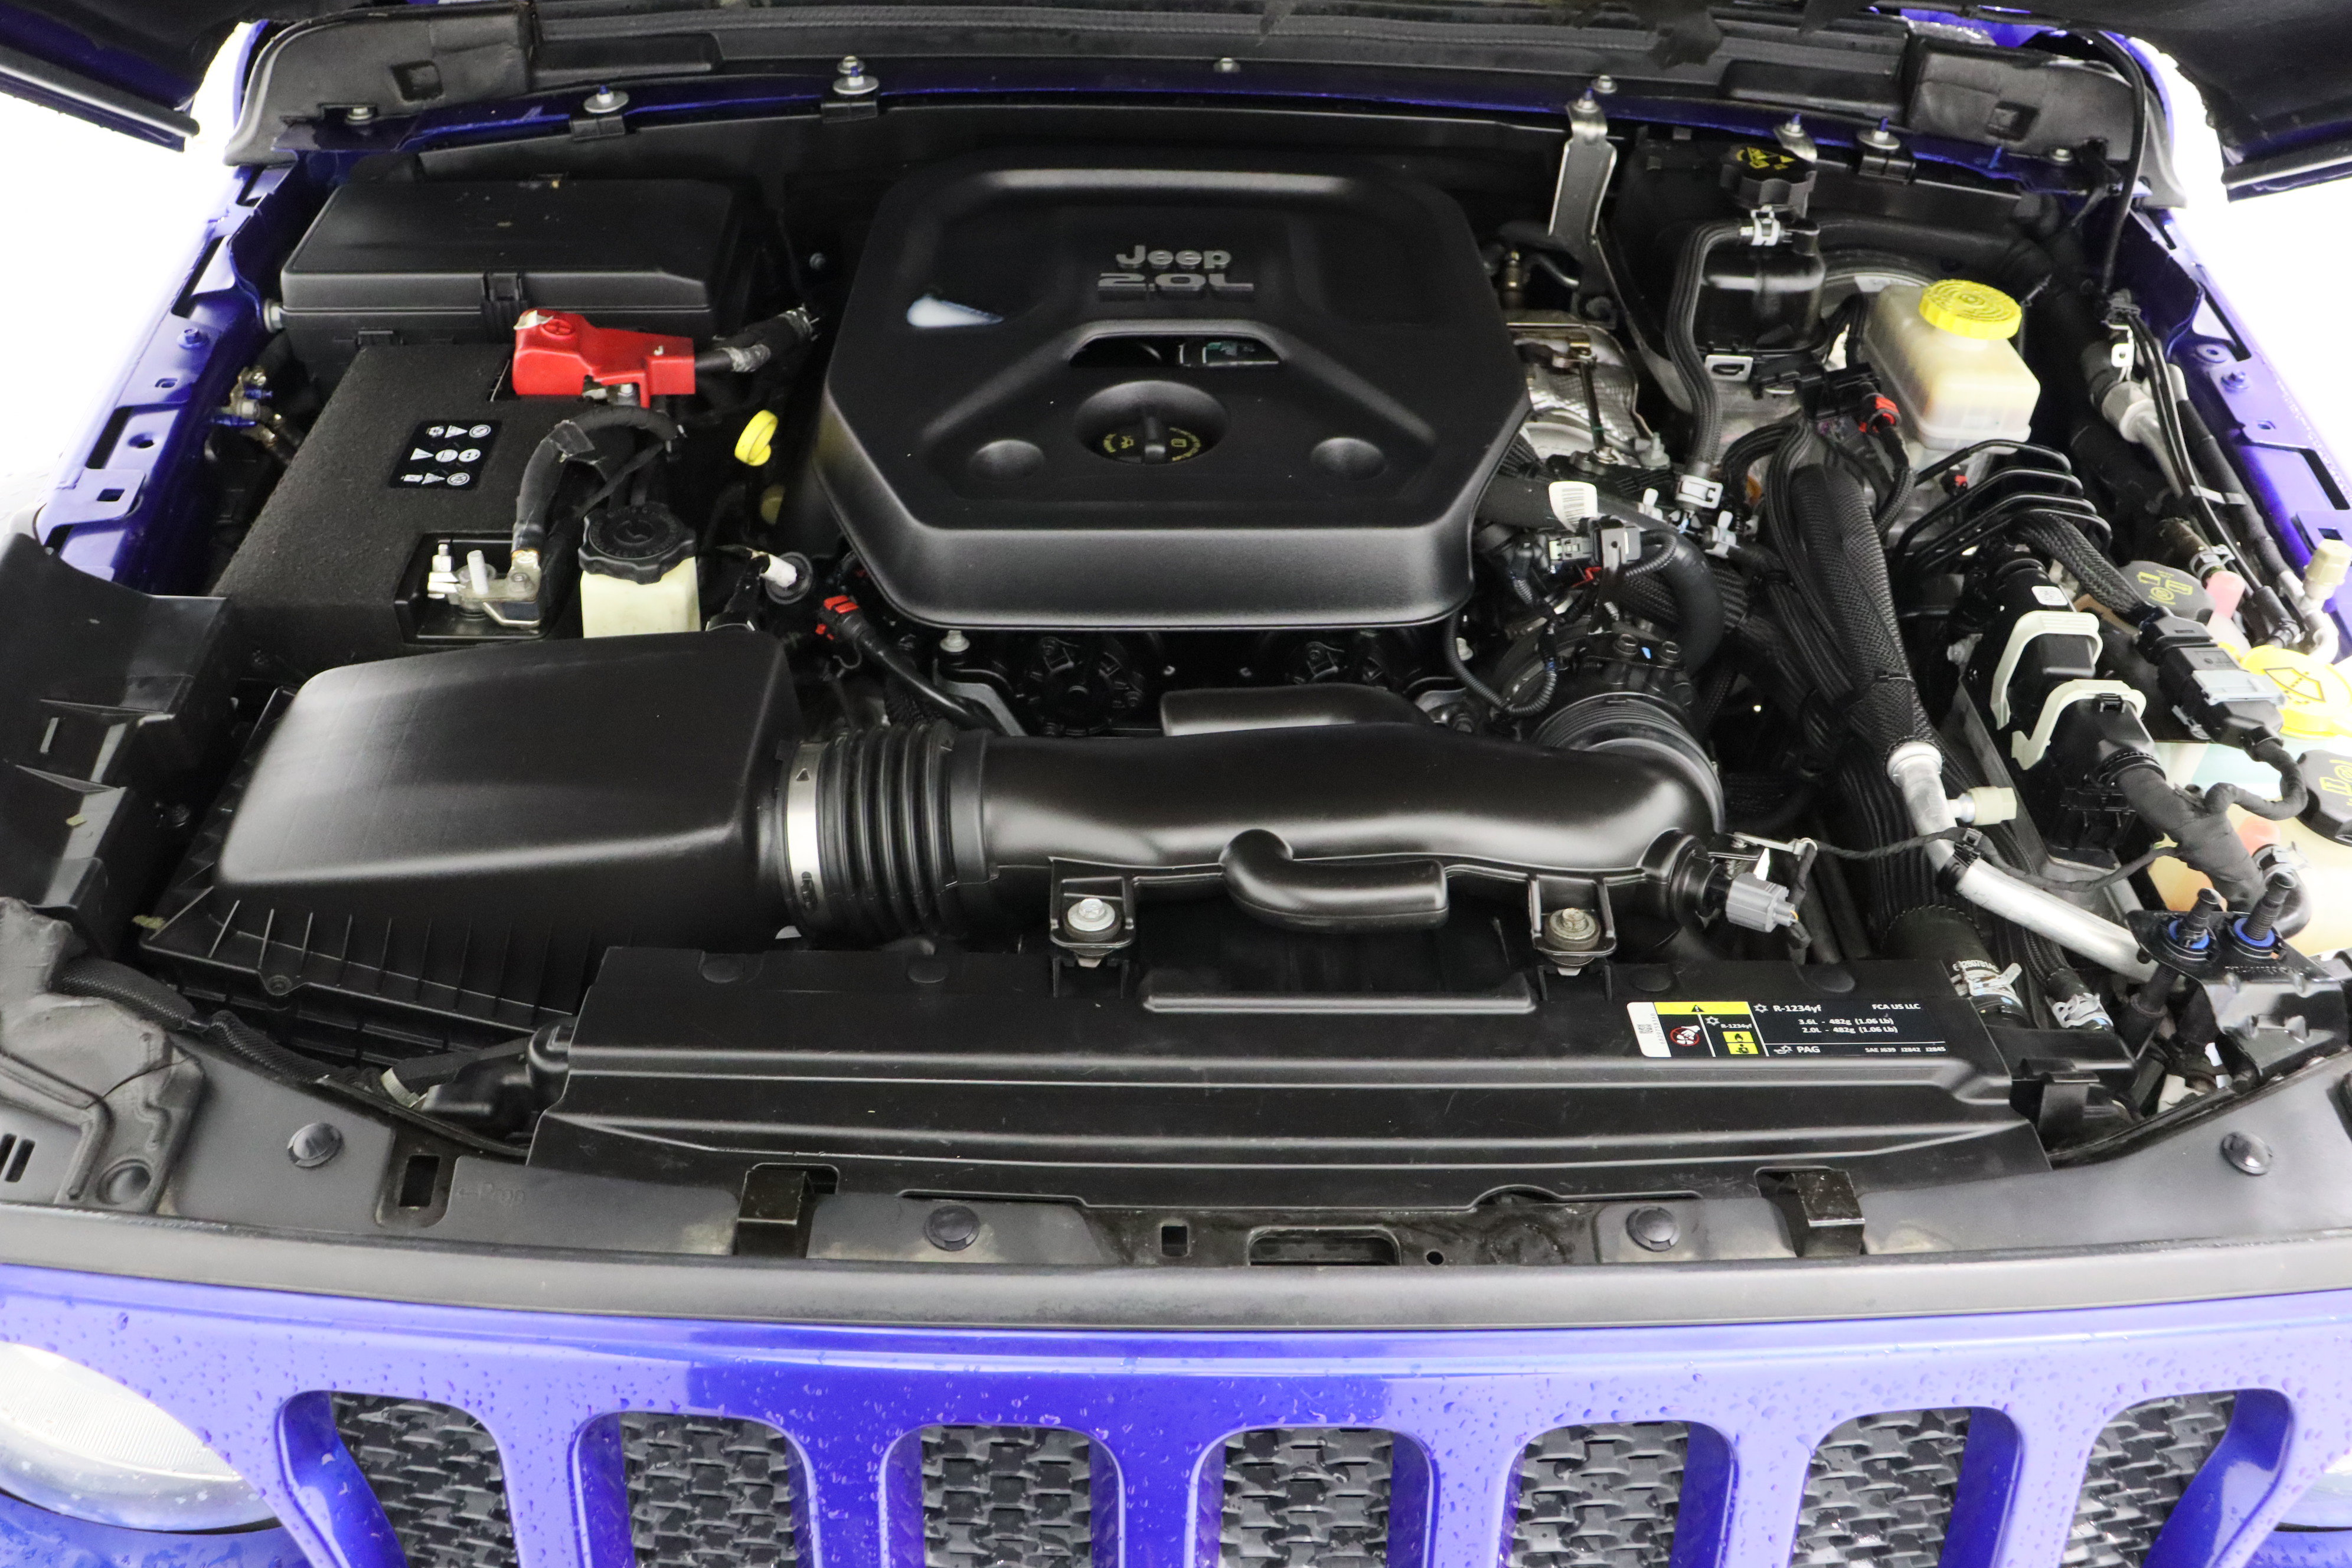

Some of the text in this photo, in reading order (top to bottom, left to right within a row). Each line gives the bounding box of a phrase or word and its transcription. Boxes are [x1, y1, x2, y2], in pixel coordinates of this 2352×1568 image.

[1115, 245, 1231, 269] Jeep
[1097, 272, 1255, 292] 2.0L
[1773, 1004, 1821, 1013] R-1234yf
